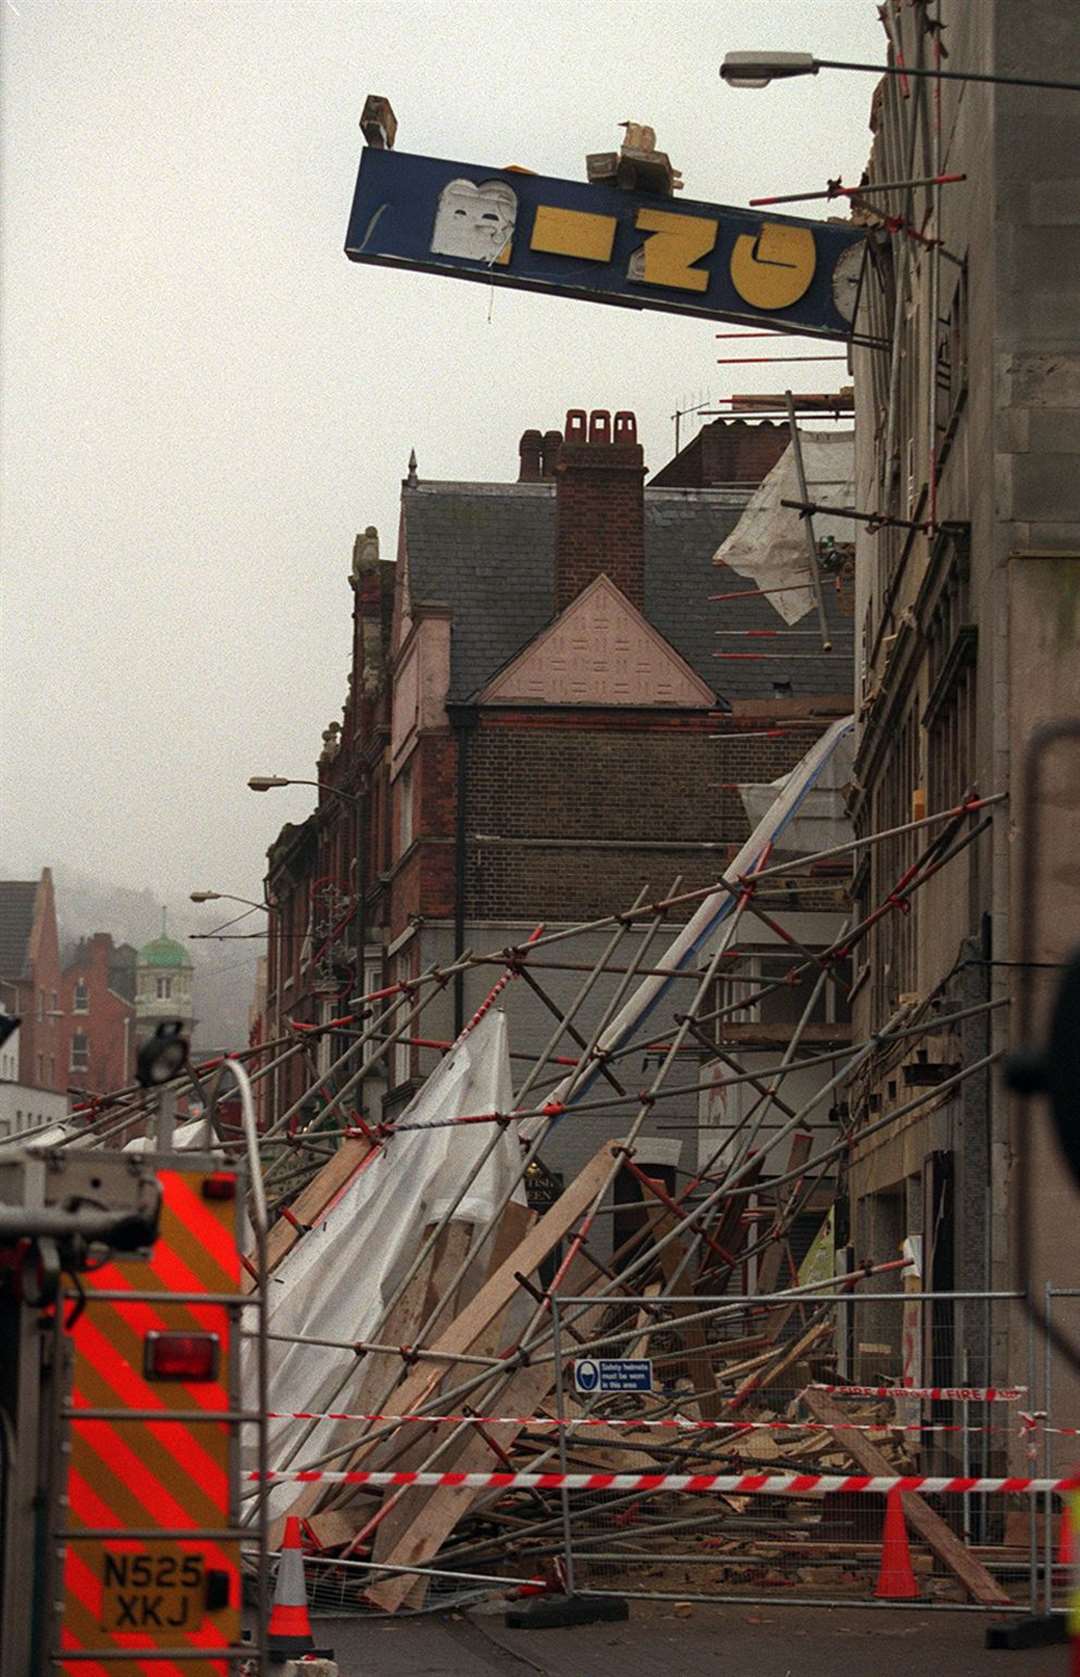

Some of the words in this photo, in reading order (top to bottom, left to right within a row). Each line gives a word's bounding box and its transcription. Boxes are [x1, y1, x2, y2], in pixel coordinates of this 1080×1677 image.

[946, 1388, 981, 1400] FIRE
[104, 1553, 203, 1587] N525
[117, 1594, 189, 1627] XKJ
